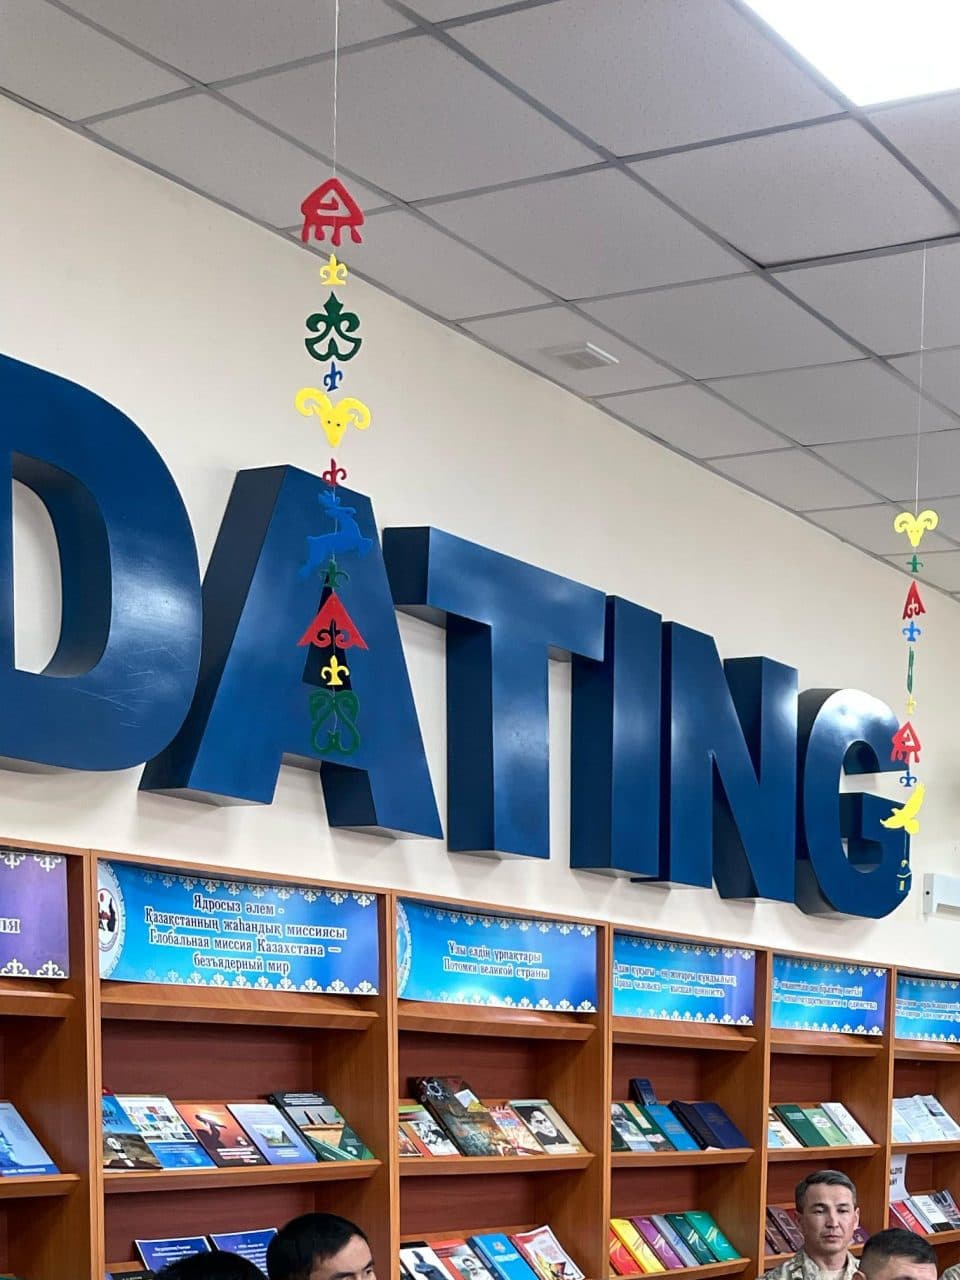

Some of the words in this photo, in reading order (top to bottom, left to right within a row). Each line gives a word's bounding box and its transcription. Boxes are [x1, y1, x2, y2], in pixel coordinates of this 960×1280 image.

[194, 894, 241, 912] Ядросыз
[246, 901, 274, 915] әлем
[145, 906, 220, 931] Қазақстанның
[287, 925, 346, 939] миссиясы
[150, 928, 210, 948] Глобальная
[214, 937, 252, 951] миссия
[258, 937, 324, 957] Казахстана
[194, 953, 264, 972] безъядерный
[269, 960, 289, 974] мир
[444, 957, 477, 973] Потомки
[481, 964, 513, 977] великой
[517, 968, 549, 981] страны
